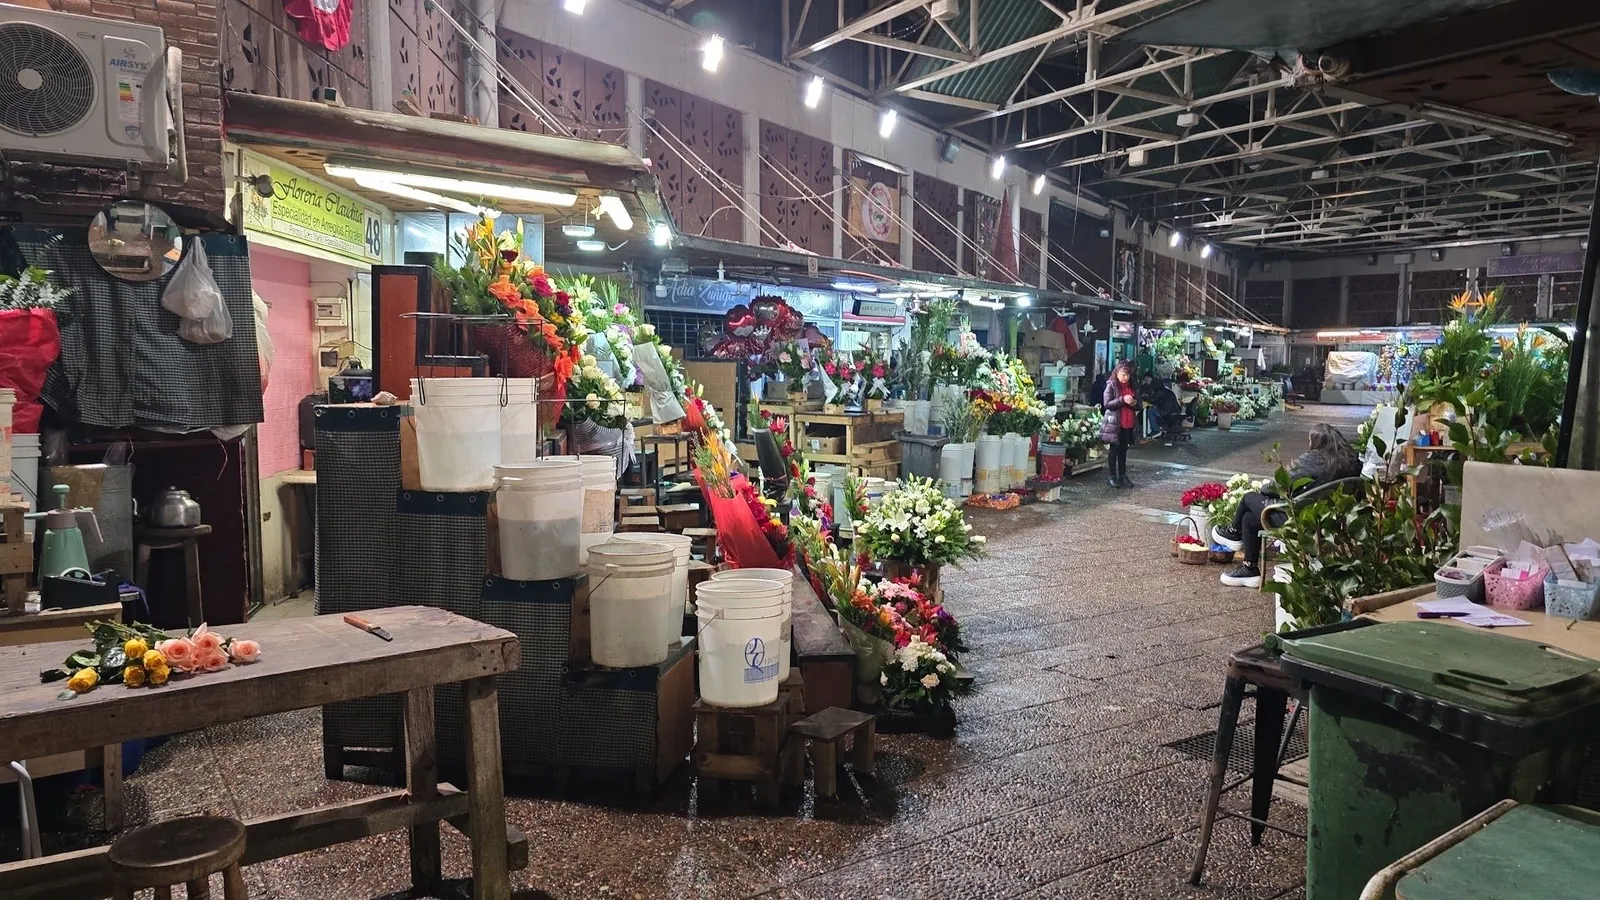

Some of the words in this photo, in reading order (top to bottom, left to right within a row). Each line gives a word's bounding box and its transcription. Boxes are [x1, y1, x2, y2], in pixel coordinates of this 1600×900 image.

[109, 58, 147, 70] AIRSYS
[272, 200, 311, 226] Especialidad
[312, 216, 321, 228] en
[322, 216, 344, 238] Arreglos
[365, 216, 381, 257] 48
[665, 281, 695, 303] Adia
